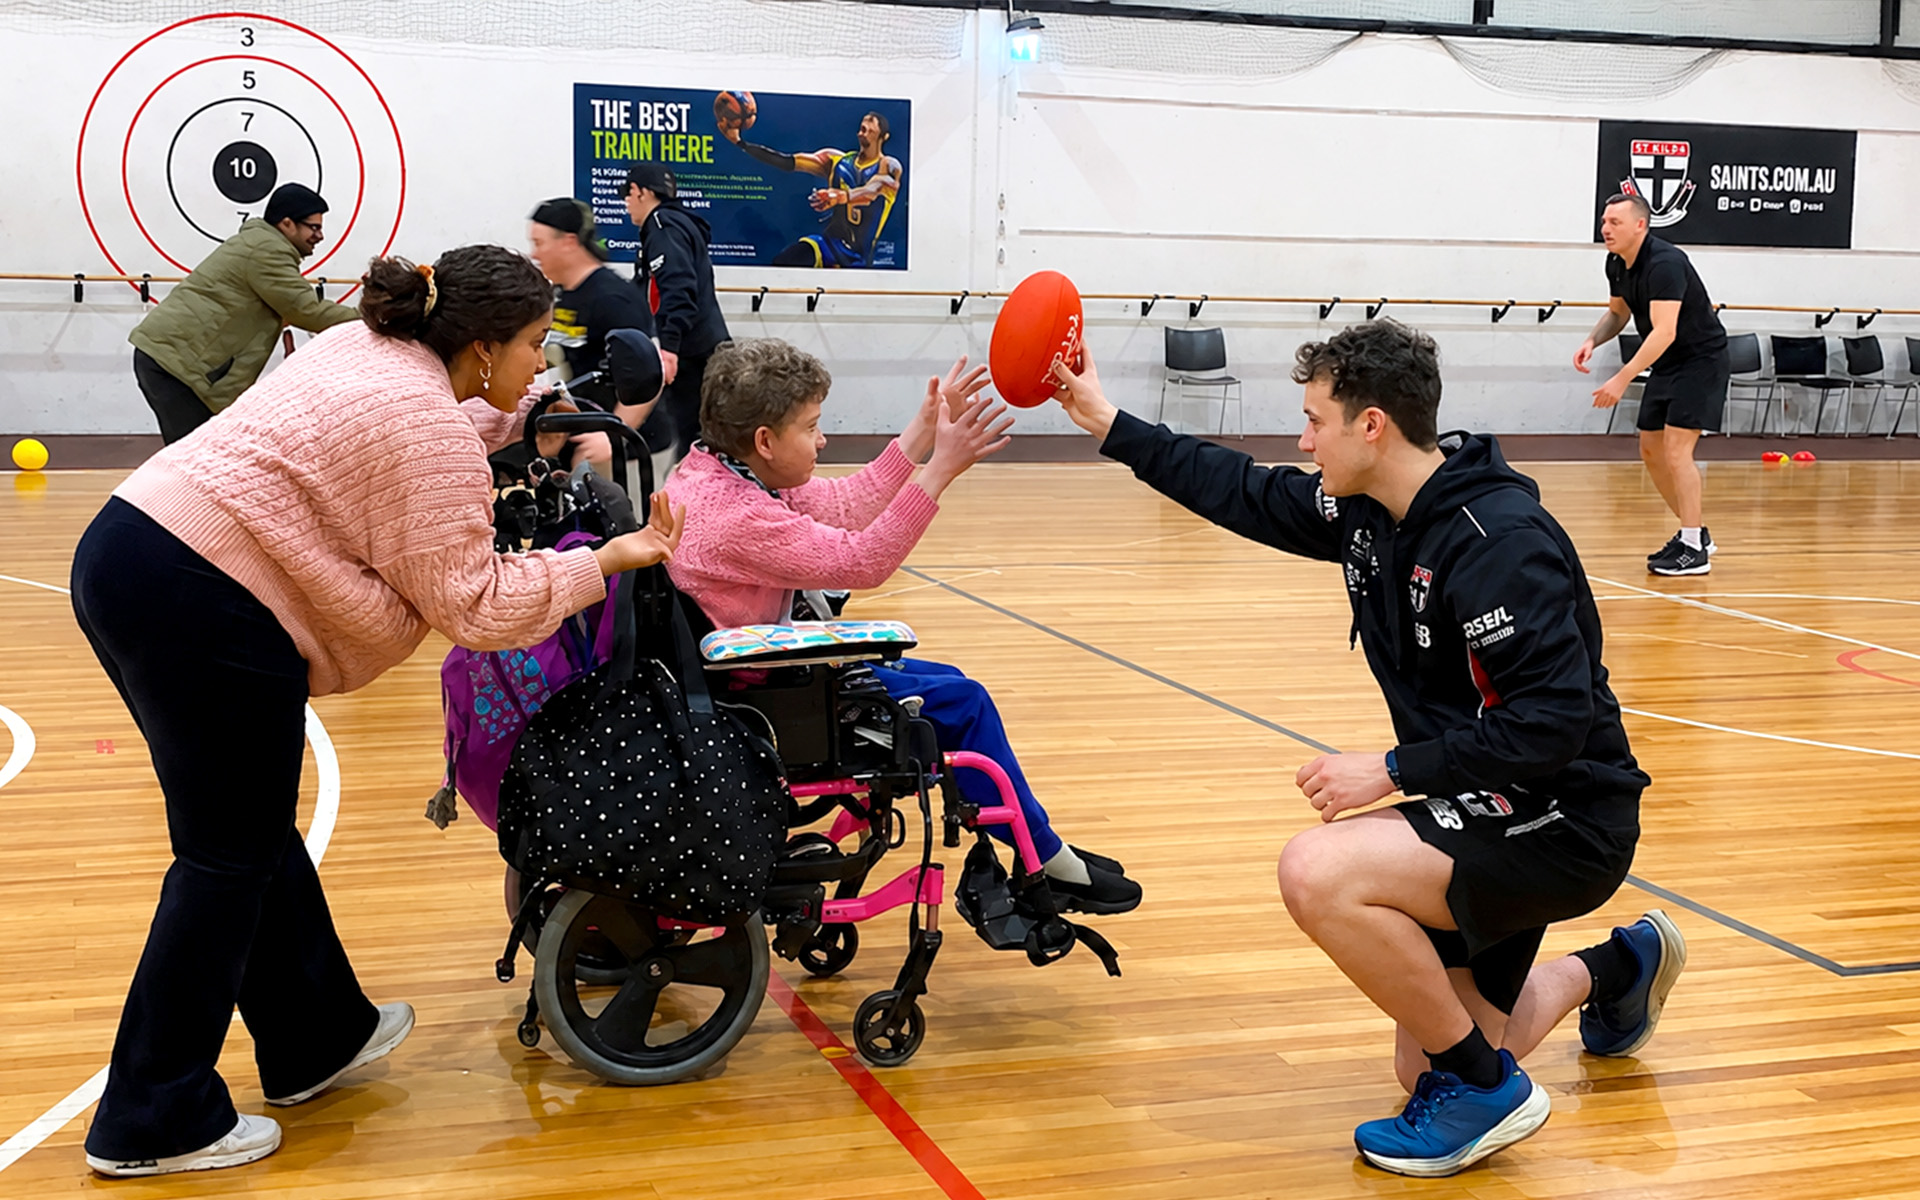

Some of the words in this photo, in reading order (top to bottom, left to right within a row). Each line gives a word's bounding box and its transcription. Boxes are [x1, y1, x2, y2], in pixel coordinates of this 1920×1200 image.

[240, 27, 255, 47] 3
[242, 70, 256, 90] 5
[241, 112, 254, 133] 7
[590, 99, 632, 130] THE
[638, 101, 691, 133] BEST
[591, 130, 652, 161] TRAIN
[660, 133, 714, 164] HERE
[1635, 143, 1649, 153] ST
[230, 157, 257, 178] 10
[1710, 164, 1836, 194] SAINTS.COM.AU
